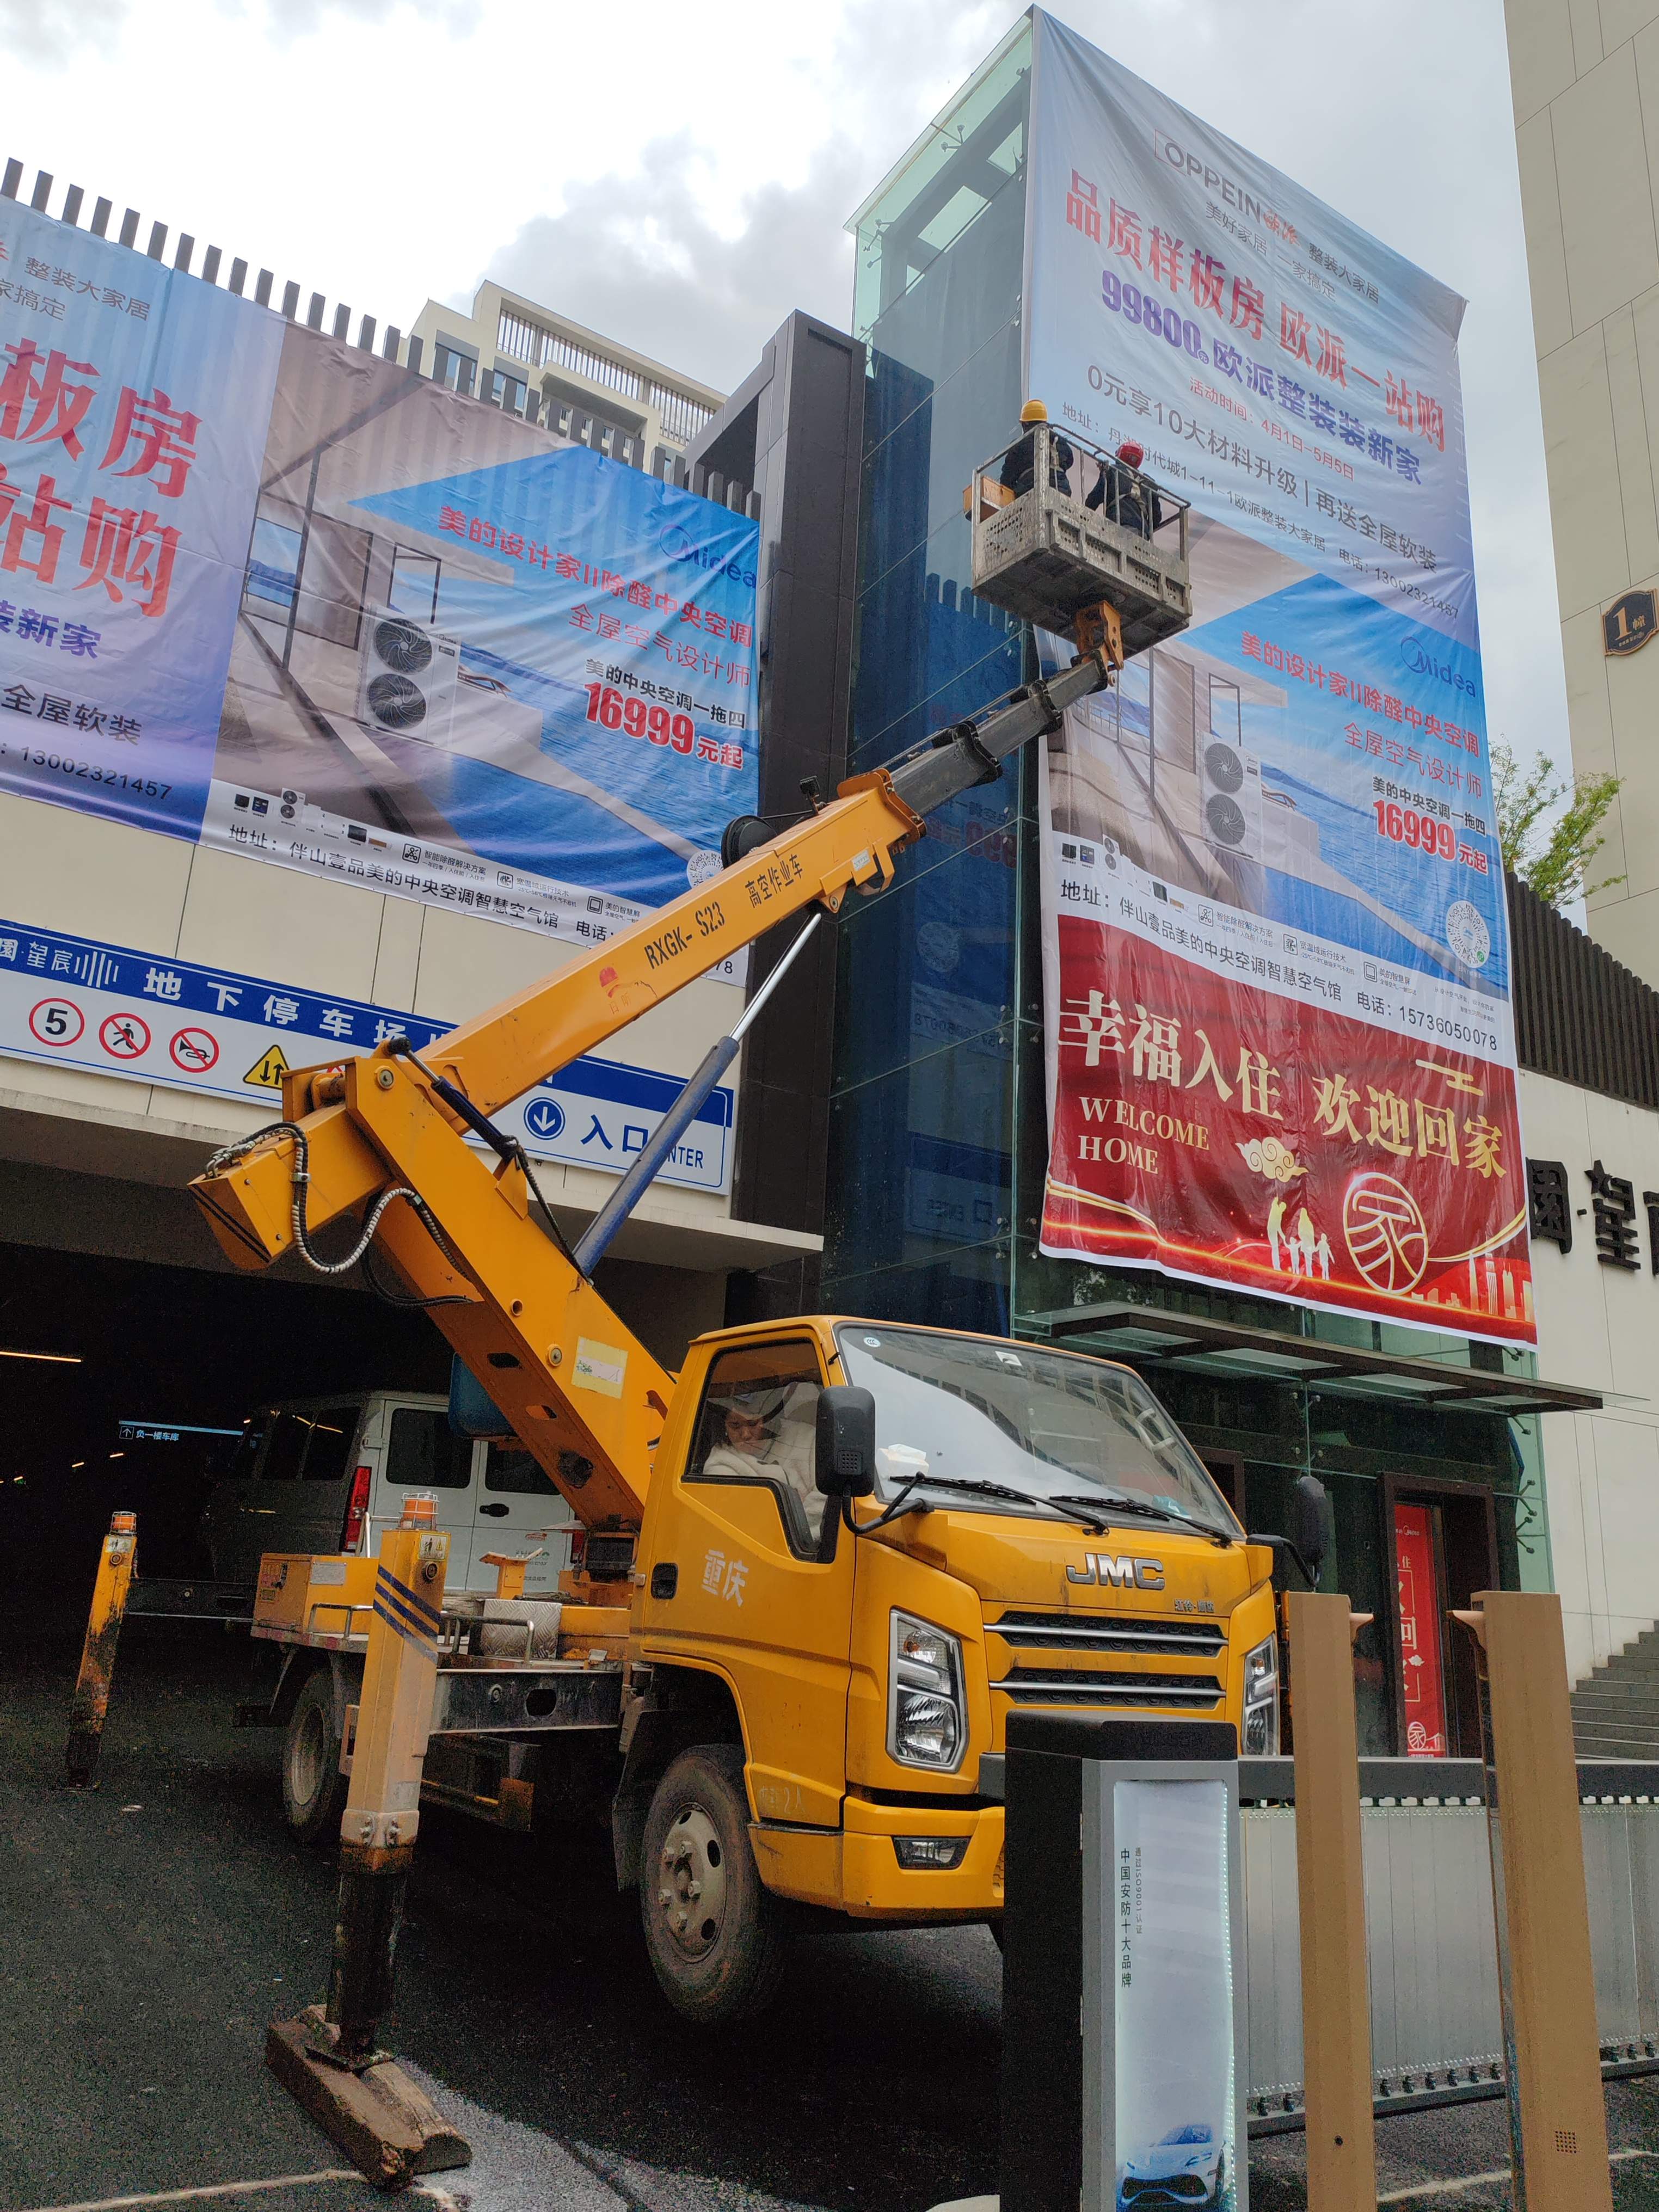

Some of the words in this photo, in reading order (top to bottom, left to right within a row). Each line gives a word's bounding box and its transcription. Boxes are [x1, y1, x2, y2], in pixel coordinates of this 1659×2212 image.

[1164, 140, 1261, 219] OPPEIN
[1309, 243, 1380, 304] 整装大家居
[1205, 201, 1268, 256] 美好家居
[1277, 254, 1336, 302] 一家搞定
[26, 256, 150, 321] 整装大家居
[1066, 168, 1266, 342] 品质样板房
[1280, 301, 1446, 453] 欧派一站购
[0, 337, 203, 499] 板房
[0, 463, 183, 618] 站购
[659, 523, 757, 590] Midea
[569, 603, 751, 688] 全屋空气设计师
[1400, 635, 1477, 698] Midea
[2, 684, 143, 746] 全屋软装
[586, 658, 746, 729] 美的中央空调一拖四
[1344, 721, 1482, 800] 全屋空气设计师
[1373, 776, 1486, 837] 美的中央空调一拖四
[228, 824, 560, 929] 地址：伴山壹品美的中央空调智慧空气馆
[424, 849, 487, 876] 智能除醛解决方案
[745, 853, 803, 909] 高空作业车
[605, 901, 641, 918] 美的智慧屏
[695, 901, 726, 937] S23
[1060, 878, 1343, 1003] 地址：伴山壹品美的中央空调智慧空气馆
[45, 1007, 69, 1036] 5
[143, 967, 407, 1045] 地下停车场
[1058, 990, 1285, 1122] 幸福入住
[1312, 1074, 1508, 1179] 欢迎回家
[580, 1114, 650, 1153] 入口
[668, 1143, 704, 1170] NTER
[1077, 1135, 1159, 1176] HOME
[1079, 1096, 1210, 1152] WELCOME
[136, 1429, 179, 1442] 负一楼车库
[701, 1549, 749, 1607] 重庆
[1066, 1552, 1166, 1590] JMC
[1121, 1848, 1132, 1988] 中国安防十大品牌
